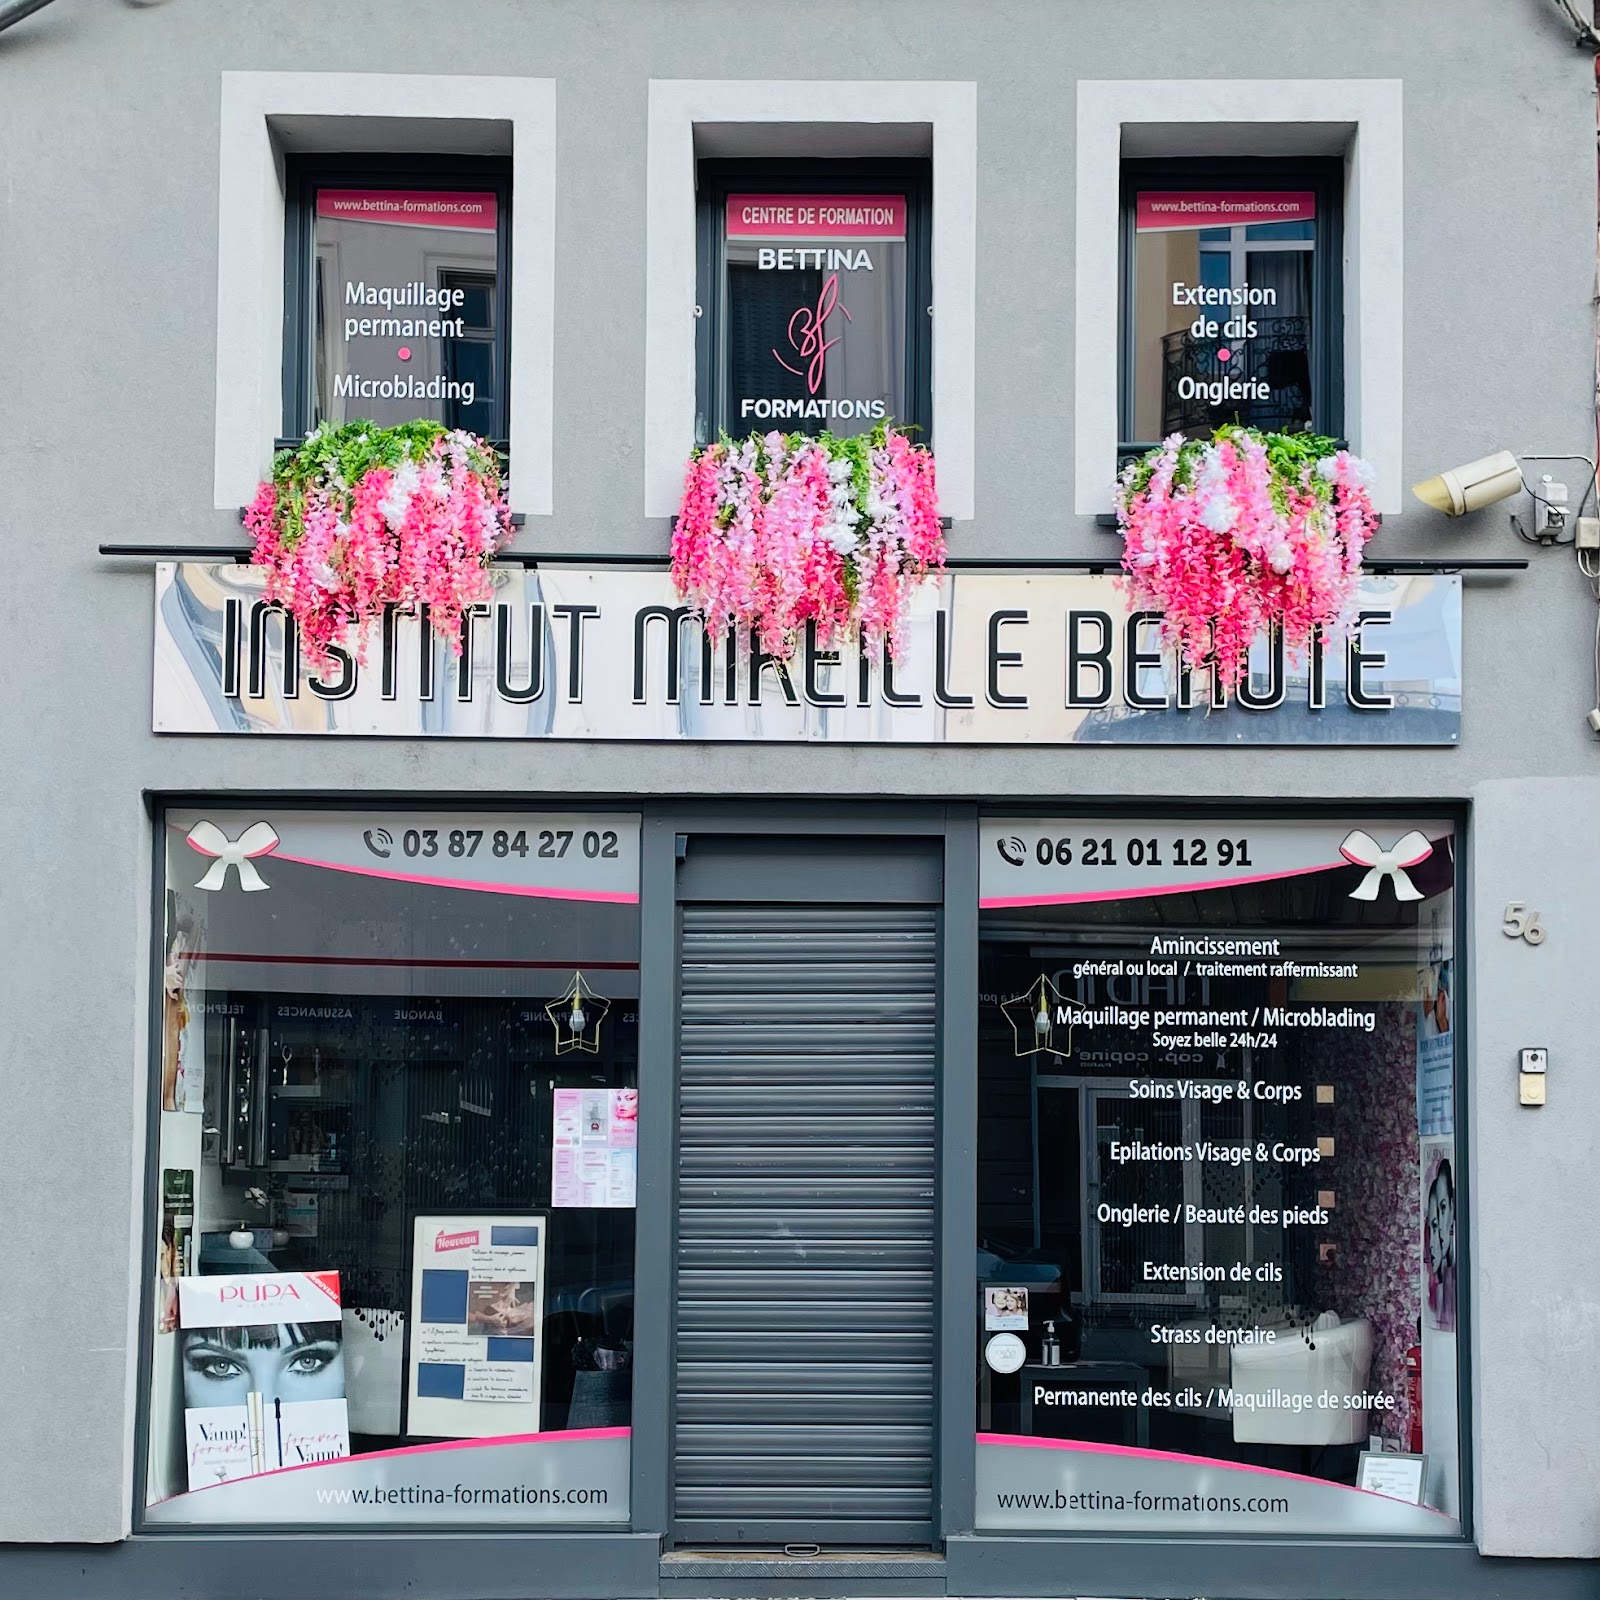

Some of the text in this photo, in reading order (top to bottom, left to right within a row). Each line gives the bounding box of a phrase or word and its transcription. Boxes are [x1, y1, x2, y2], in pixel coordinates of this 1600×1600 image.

[333, 198, 483, 214] www.bettina-formations.com
[742, 207, 893, 225] CENTRE DE FORMATION
[1151, 200, 1300, 212] www.bettina-formations.com
[758, 248, 874, 270] BETTINA
[345, 281, 465, 312] Maquillage
[1173, 282, 1276, 305] Extension
[345, 317, 465, 342] permanent
[1191, 314, 1257, 338] de cils
[333, 374, 474, 405] Microblading
[1178, 375, 1270, 406] Onglerie
[741, 399, 885, 419] FORMATIONS
[402, 829, 619, 859] 03 87 84 27 02
[1036, 837, 1252, 867] 06 21 01 12 91
[1503, 901, 1545, 945] 56
[1150, 936, 1280, 956] Amincissement
[1073, 960, 1358, 979] général ou local / traitement raffermissant
[1056, 1005, 1376, 1030] Maquillage permanent / Microblading
[1152, 1031, 1278, 1051] Soyez belle 24h/24
[1129, 1079, 1302, 1105] Soins Visage & Corps
[1111, 1141, 1321, 1167] Epilations Visage & Corps
[1097, 1203, 1329, 1229] Onglerie / Beauté des pieds
[436, 1234, 477, 1249] Nouveau
[1143, 1261, 1283, 1282] Extension de cils
[220, 1284, 301, 1303] PUPA
[1151, 1324, 1277, 1344] Strass dentaire
[1034, 1386, 1138, 1406] Permanente
[1141, 1387, 1171, 1407] des
[1175, 1387, 1202, 1407] cils
[1205, 1388, 1214, 1408] /
[1218, 1388, 1313, 1414] Maquillage
[1317, 1389, 1339, 1409] de
[1343, 1390, 1395, 1410] soirée
[198, 1422, 247, 1444] Vamp!
[283, 1432, 345, 1456] forever
[191, 1443, 250, 1466] forever
[316, 1484, 609, 1505] www.bettina-formations.com
[997, 1489, 1289, 1513] www.bettina-formations.com
